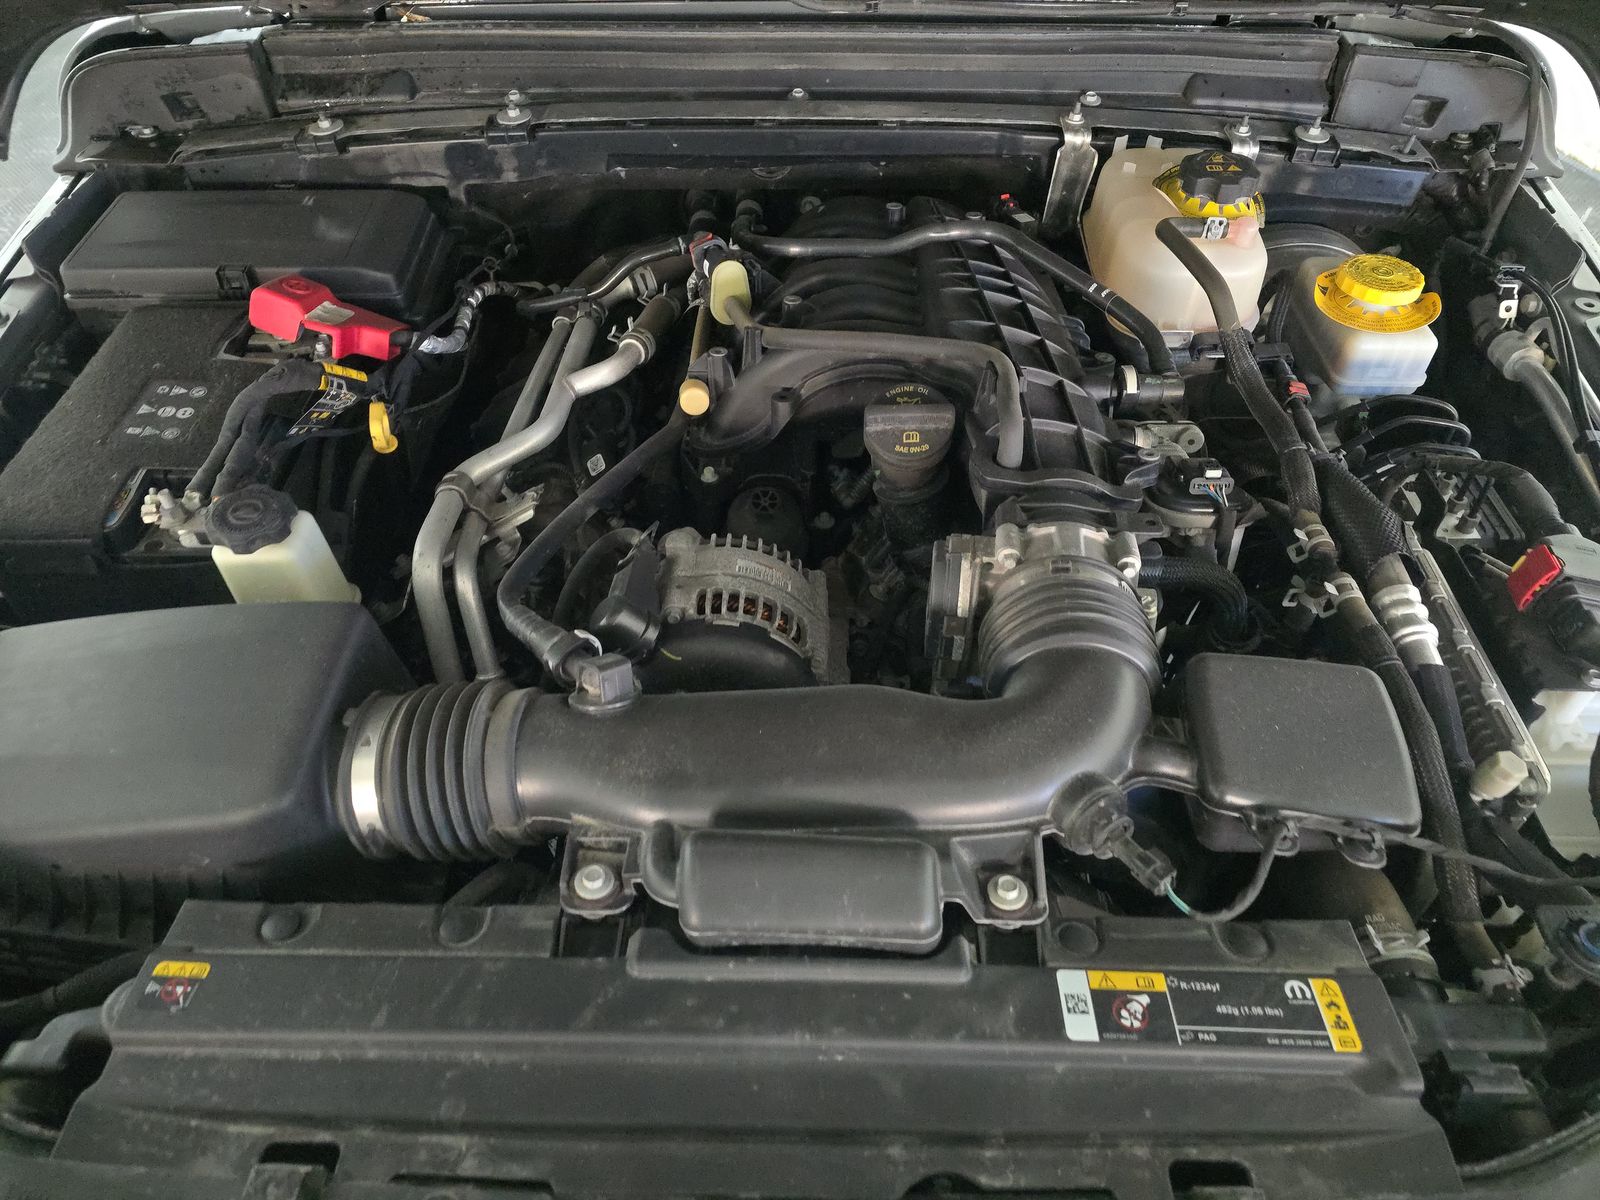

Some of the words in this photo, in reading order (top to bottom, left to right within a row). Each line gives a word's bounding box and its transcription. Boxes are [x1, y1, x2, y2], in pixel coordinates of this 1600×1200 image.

[885, 386, 915, 398] ENGINE
[917, 386, 929, 396] OIL
[894, 444, 909, 453] SAE
